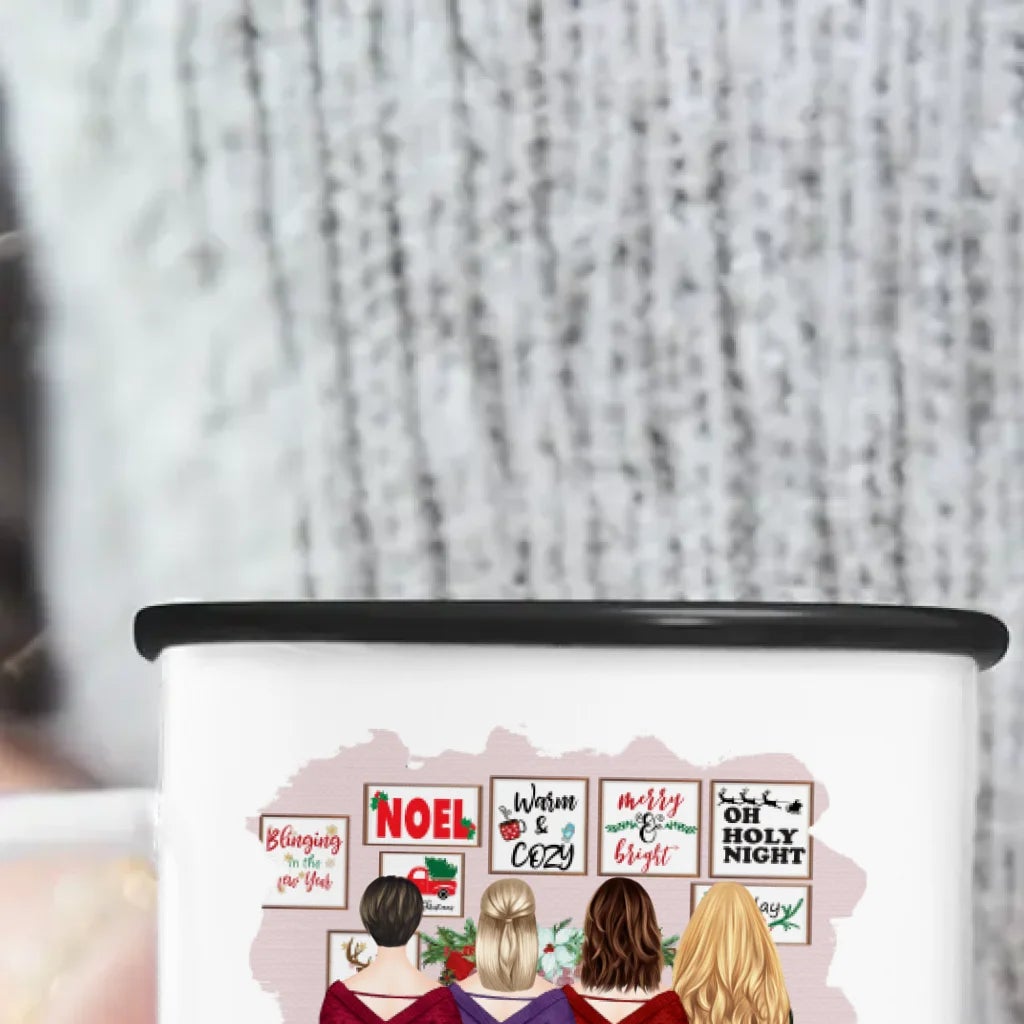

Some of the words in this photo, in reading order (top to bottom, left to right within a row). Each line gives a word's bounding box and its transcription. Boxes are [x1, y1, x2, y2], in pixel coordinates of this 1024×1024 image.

[514, 783, 578, 813] Warm
[618, 787, 684, 818] merry
[376, 797, 472, 840] NOEL
[534, 815, 549, 835] &
[723, 806, 761, 824] OH
[266, 824, 343, 855] Blinging
[722, 827, 799, 844] HOLY
[614, 838, 680, 873] bright
[722, 846, 806, 864] NIGHT
